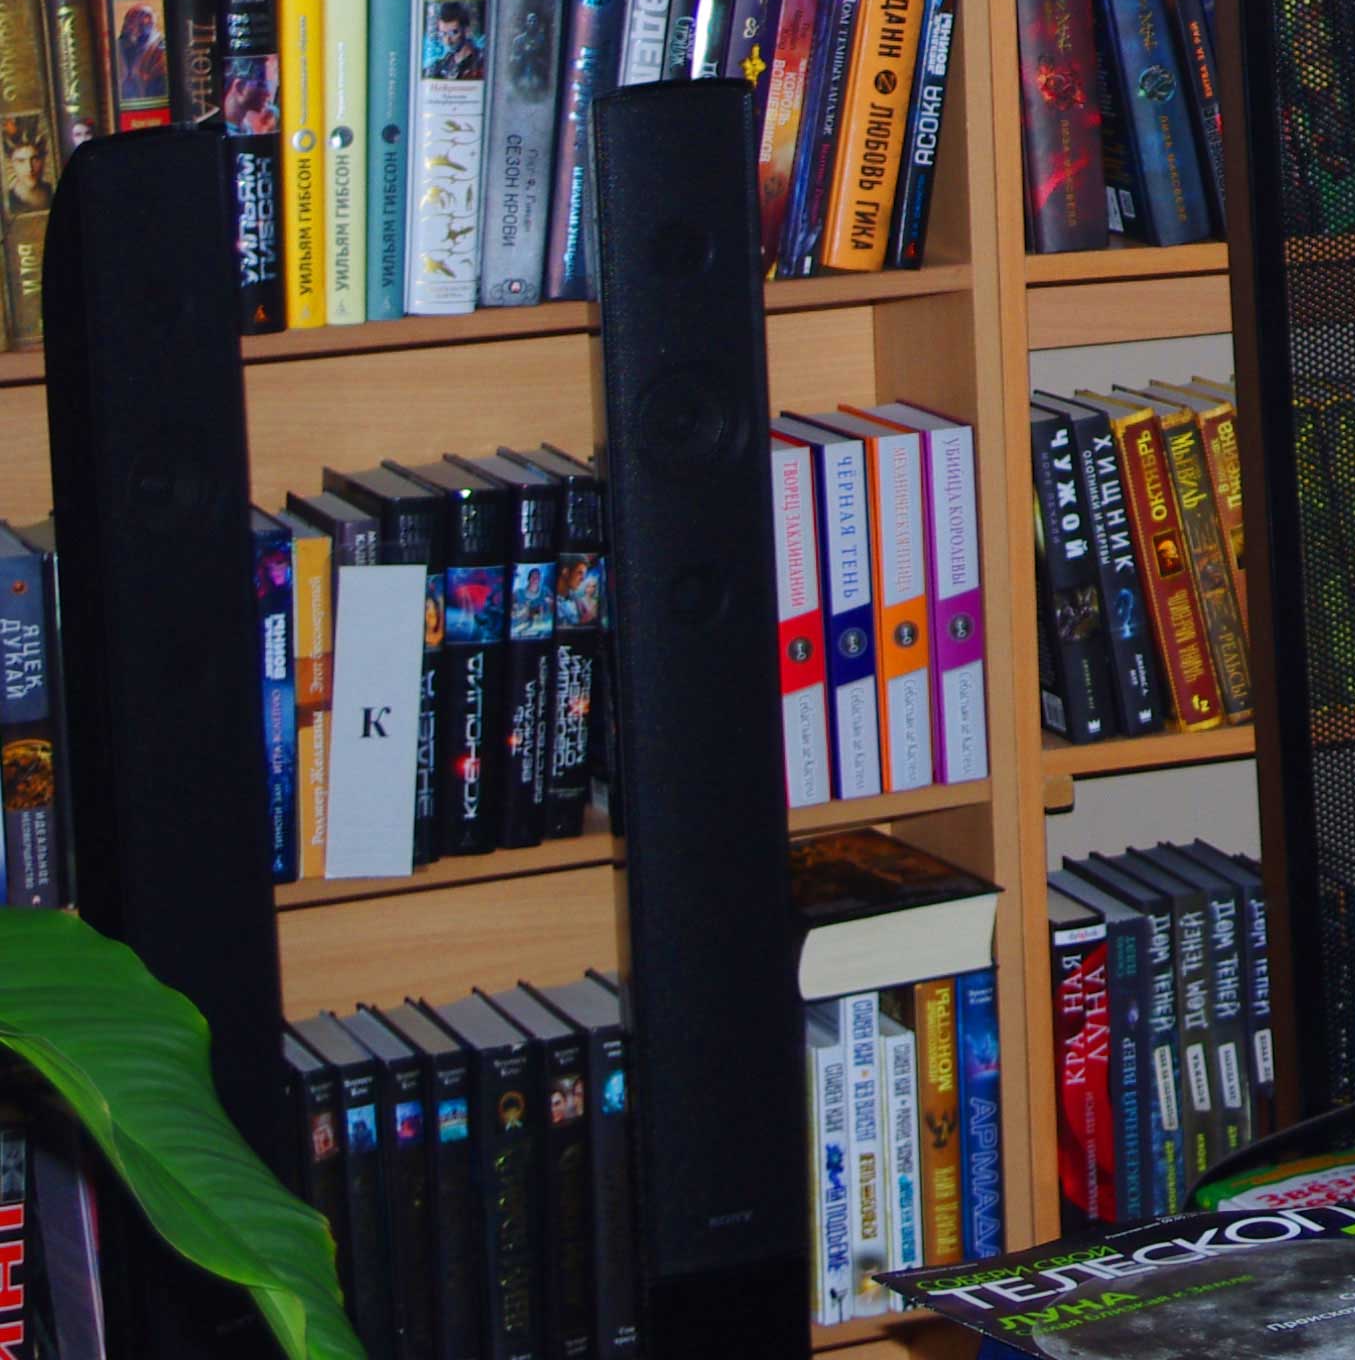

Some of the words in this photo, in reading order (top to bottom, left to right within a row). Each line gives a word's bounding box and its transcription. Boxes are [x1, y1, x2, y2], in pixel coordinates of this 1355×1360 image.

[931, 12, 951, 76] ВОЙНЫ
[857, 101, 891, 191] ЛЮБОВЬ
[915, 85, 940, 166] АСОКА
[296, 157, 312, 222] ГИБСОН
[333, 154, 350, 217] ГИБСОН
[382, 151, 398, 215] ГИБСОН
[504, 134, 522, 188] СЕЗОН
[236, 152, 259, 287] УИЛЬЯМ
[501, 193, 519, 246] КРОВИ
[850, 199, 877, 252] ГИКА
[297, 225, 313, 295] УИЛЬЯМ
[334, 223, 351, 291] УИЛЬЯМ
[382, 220, 398, 287] УИЛЬЯМ
[779, 462, 801, 510] ТВОРЕЦ
[834, 456, 858, 536] ЧЁРНАЯ
[940, 437, 962, 501] УБИЙЦА
[1047, 428, 1087, 559] ЧУЖОЙ
[1081, 449, 1101, 510] ОХОТНИКИ
[1134, 429, 1169, 522] ОКТЯБРЬ
[1090, 434, 1135, 573] ХИЩНИК
[1093, 513, 1103, 521] И
[783, 514, 806, 607] ЗАКЛИНАНИЙ
[839, 545, 859, 598] ТЕНЬ
[946, 505, 966, 585] КОРОЛЕВЫ
[1094, 523, 1112, 565] ЖЕРТВЫ
[0, 617, 26, 699] ДУКАЙ
[19, 624, 41, 691] ЯЦЕК
[271, 613, 286, 679] ВОЙНЫ
[309, 661, 324, 694] Этот
[462, 651, 485, 818] КСЕНОЦИД
[512, 705, 524, 755] ТЕНЬ
[522, 680, 535, 782] ВЕЛИКАНА
[551, 645, 571, 776] ГОВОРЯЩИЙ
[566, 739, 578, 766] ОТ
[310, 787, 325, 845] Роджер
[1150, 912, 1170, 959] ДОМ
[1181, 910, 1209, 977] ТЕНЕЙ
[1087, 962, 1109, 1060] ЛУНА
[1151, 970, 1175, 1032] ТЕНЕЙ
[1186, 980, 1209, 1029] ДОМ
[935, 988, 952, 1091] МОНСТРЫ
[1119, 1036, 1137, 1085] ВЕЕР
[916, 1260, 1032, 1296] СОБЕРИ
[1033, 1245, 1119, 1277] СВОЙ
[999, 1289, 1140, 1341] ЛУНА
